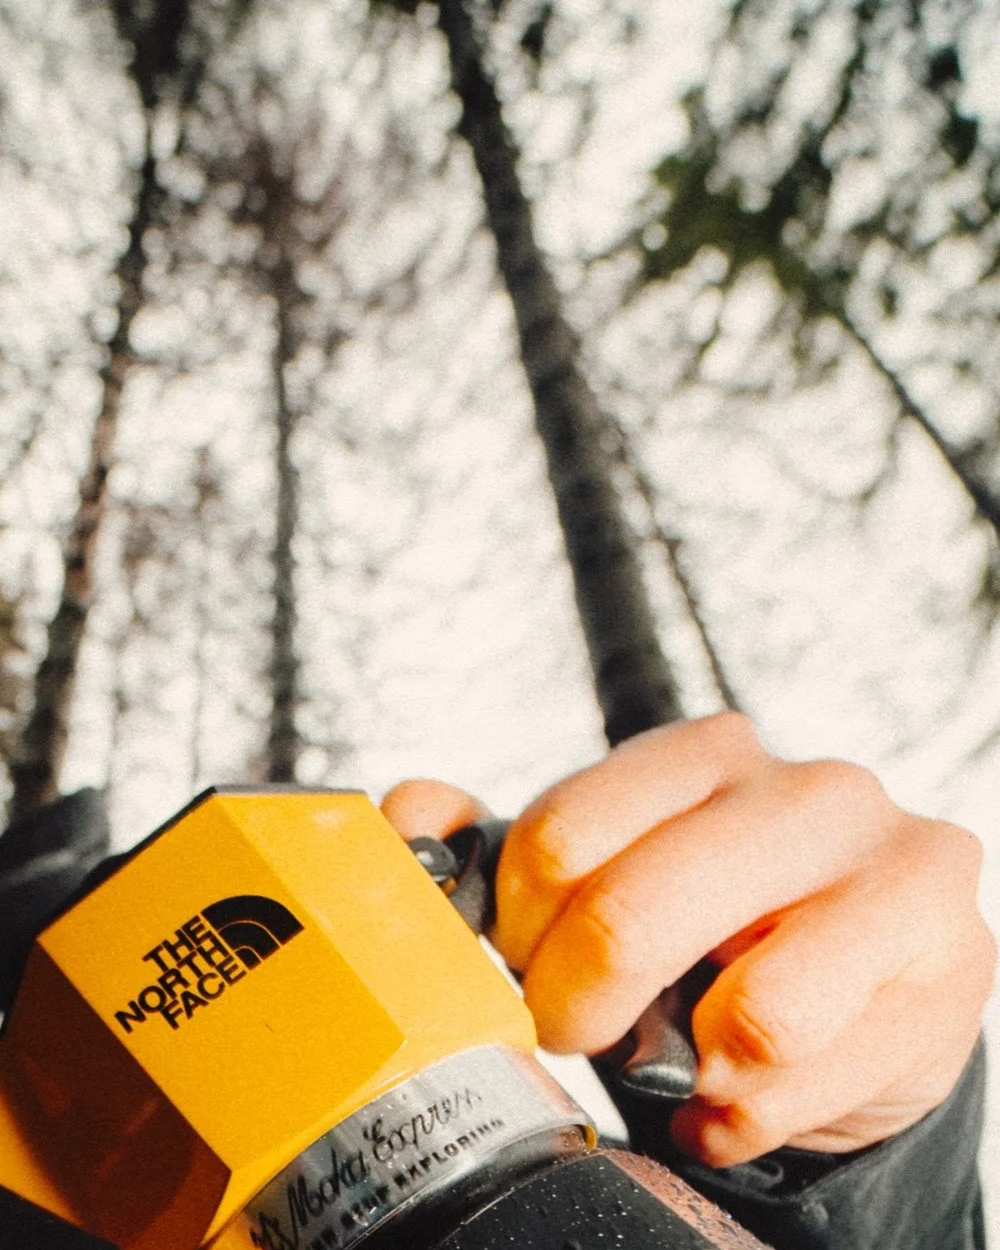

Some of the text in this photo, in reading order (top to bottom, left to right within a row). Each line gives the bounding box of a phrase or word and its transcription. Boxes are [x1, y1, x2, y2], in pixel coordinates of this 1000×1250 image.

[114, 931, 229, 1033] NORTH
[142, 915, 211, 974] THE
[160, 955, 247, 1029] FACE
[285, 1147, 371, 1249] Moka
